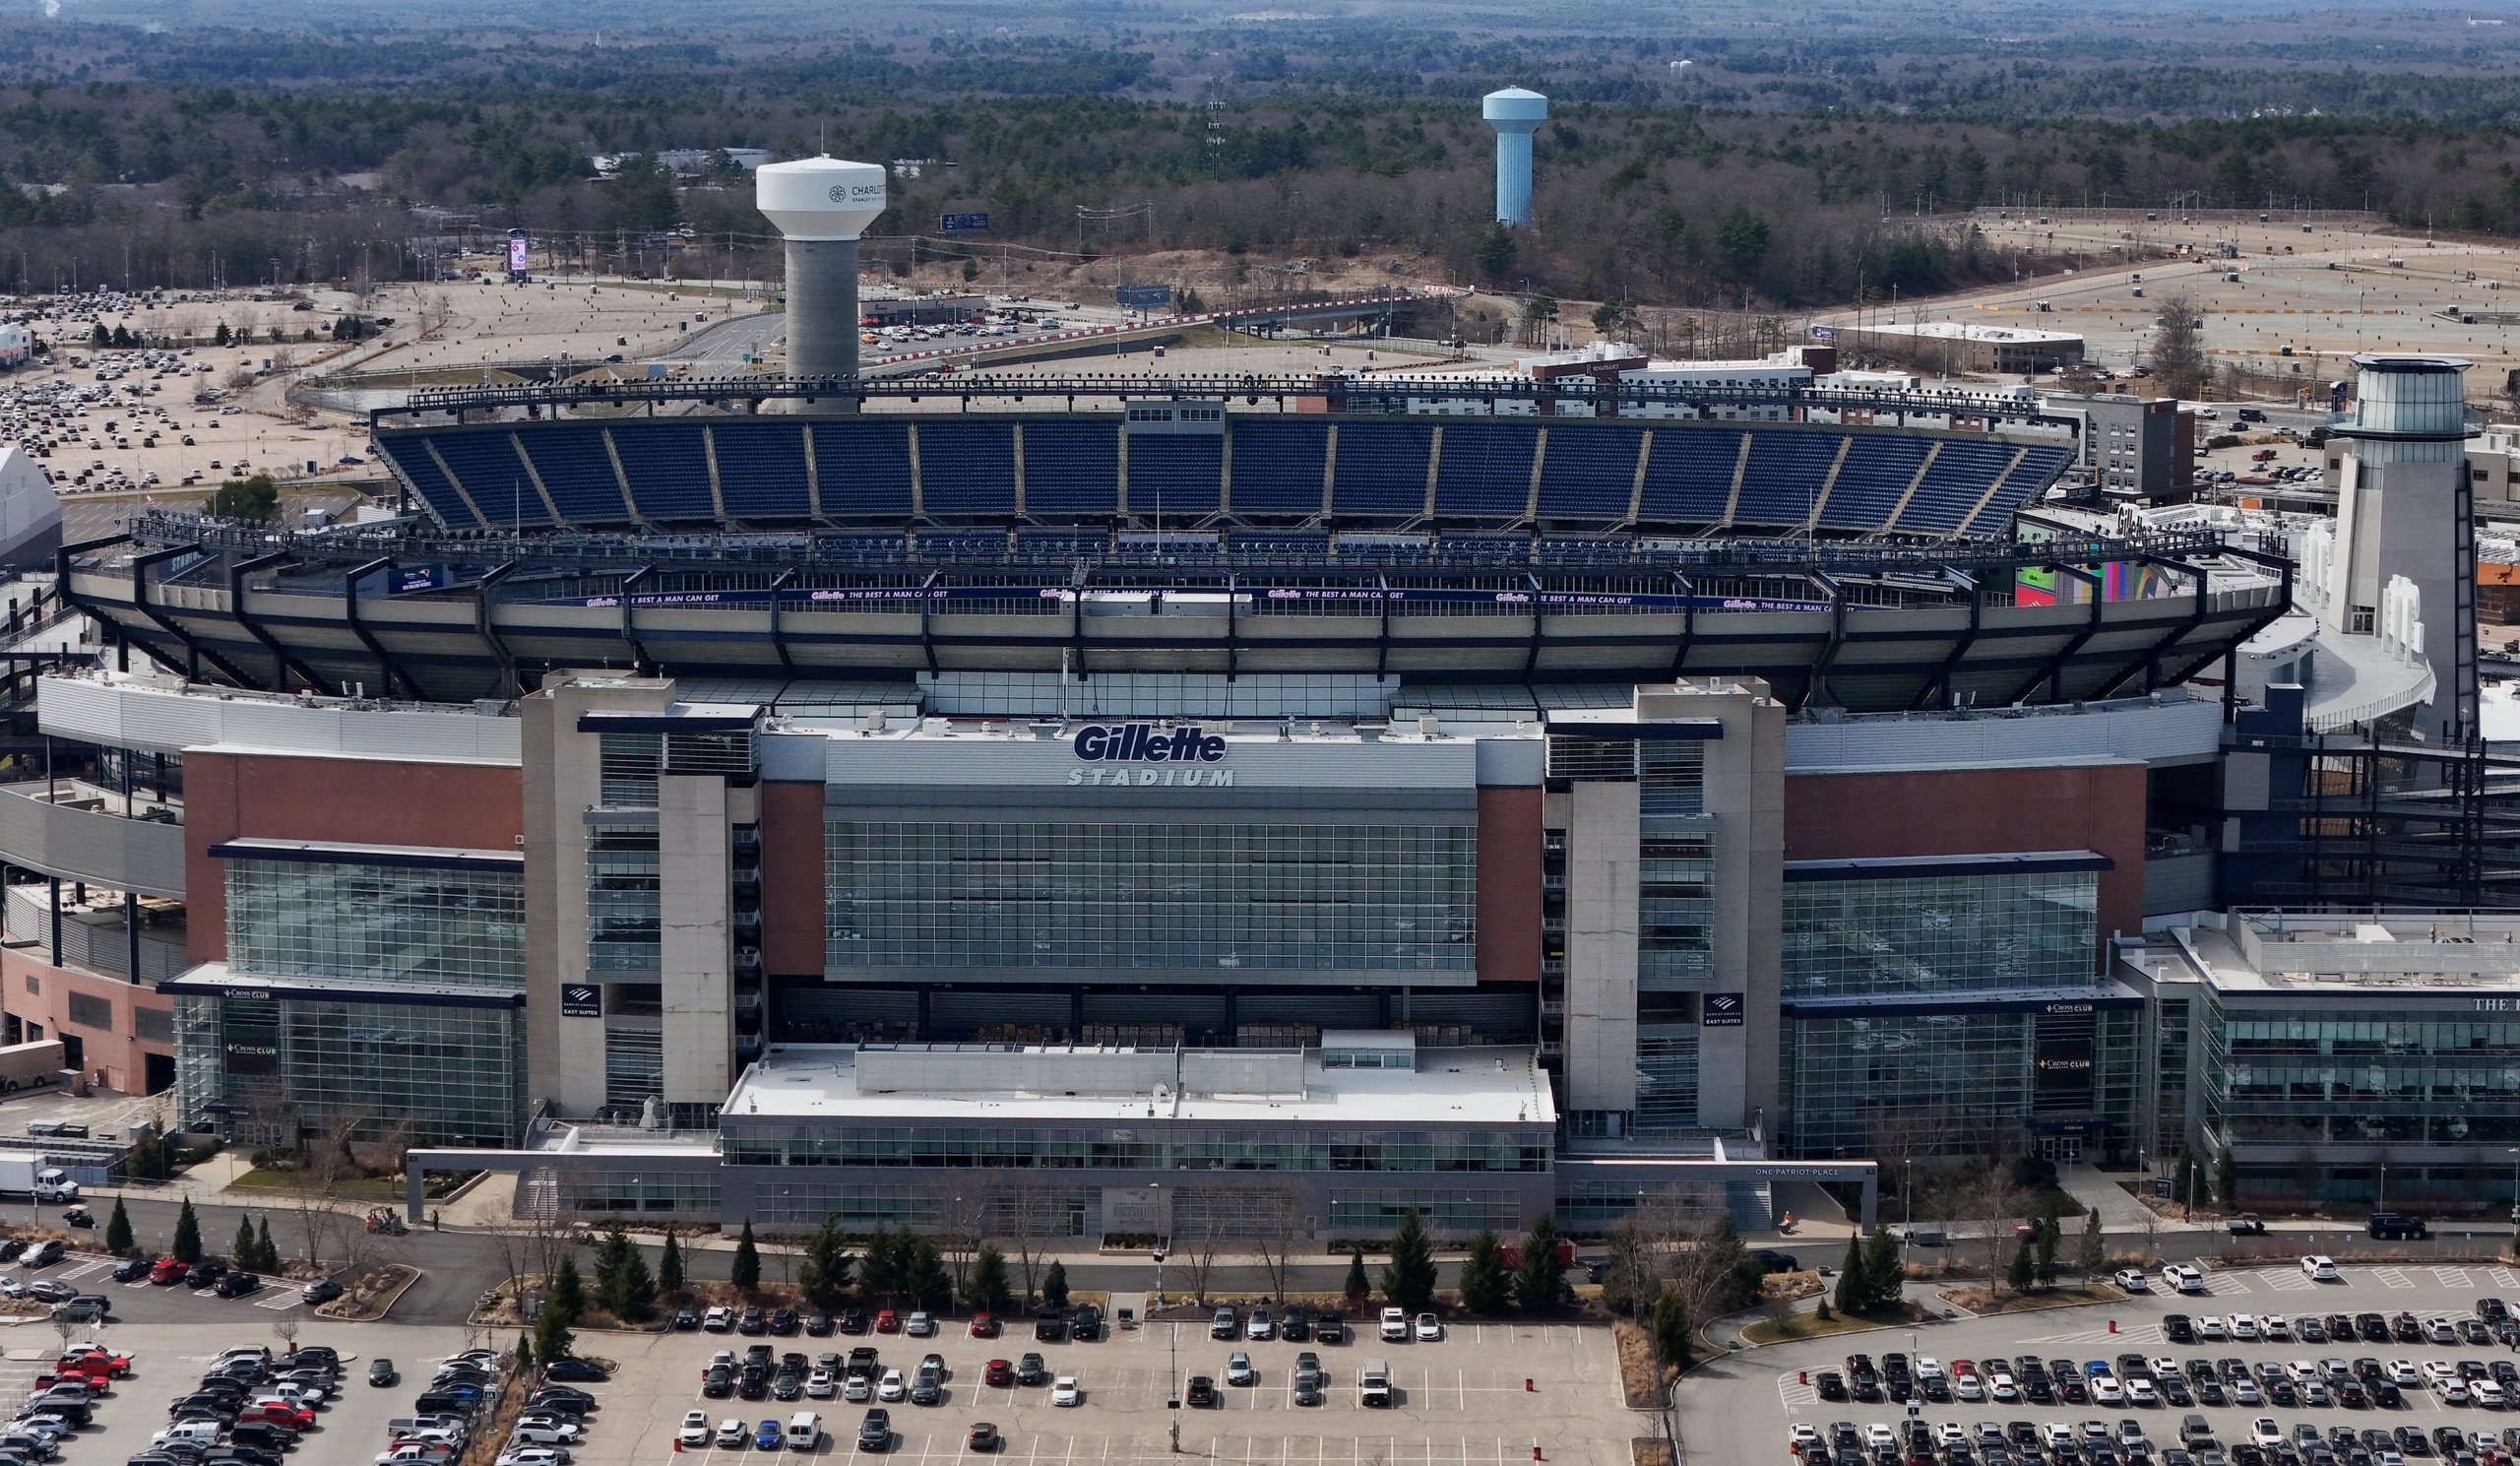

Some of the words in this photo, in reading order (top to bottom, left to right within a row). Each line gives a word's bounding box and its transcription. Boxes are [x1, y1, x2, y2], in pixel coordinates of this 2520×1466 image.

[811, 590, 845, 601] Gillette
[1268, 590, 1301, 599] Gillette
[1495, 593, 1529, 603] Gillette
[587, 597, 618, 607] Gillette
[1723, 599, 1757, 609] Gillette
[1073, 723, 1227, 763] Gillette
[1066, 768, 1233, 787] STADIUM
[2473, 998, 2509, 1011] THE
